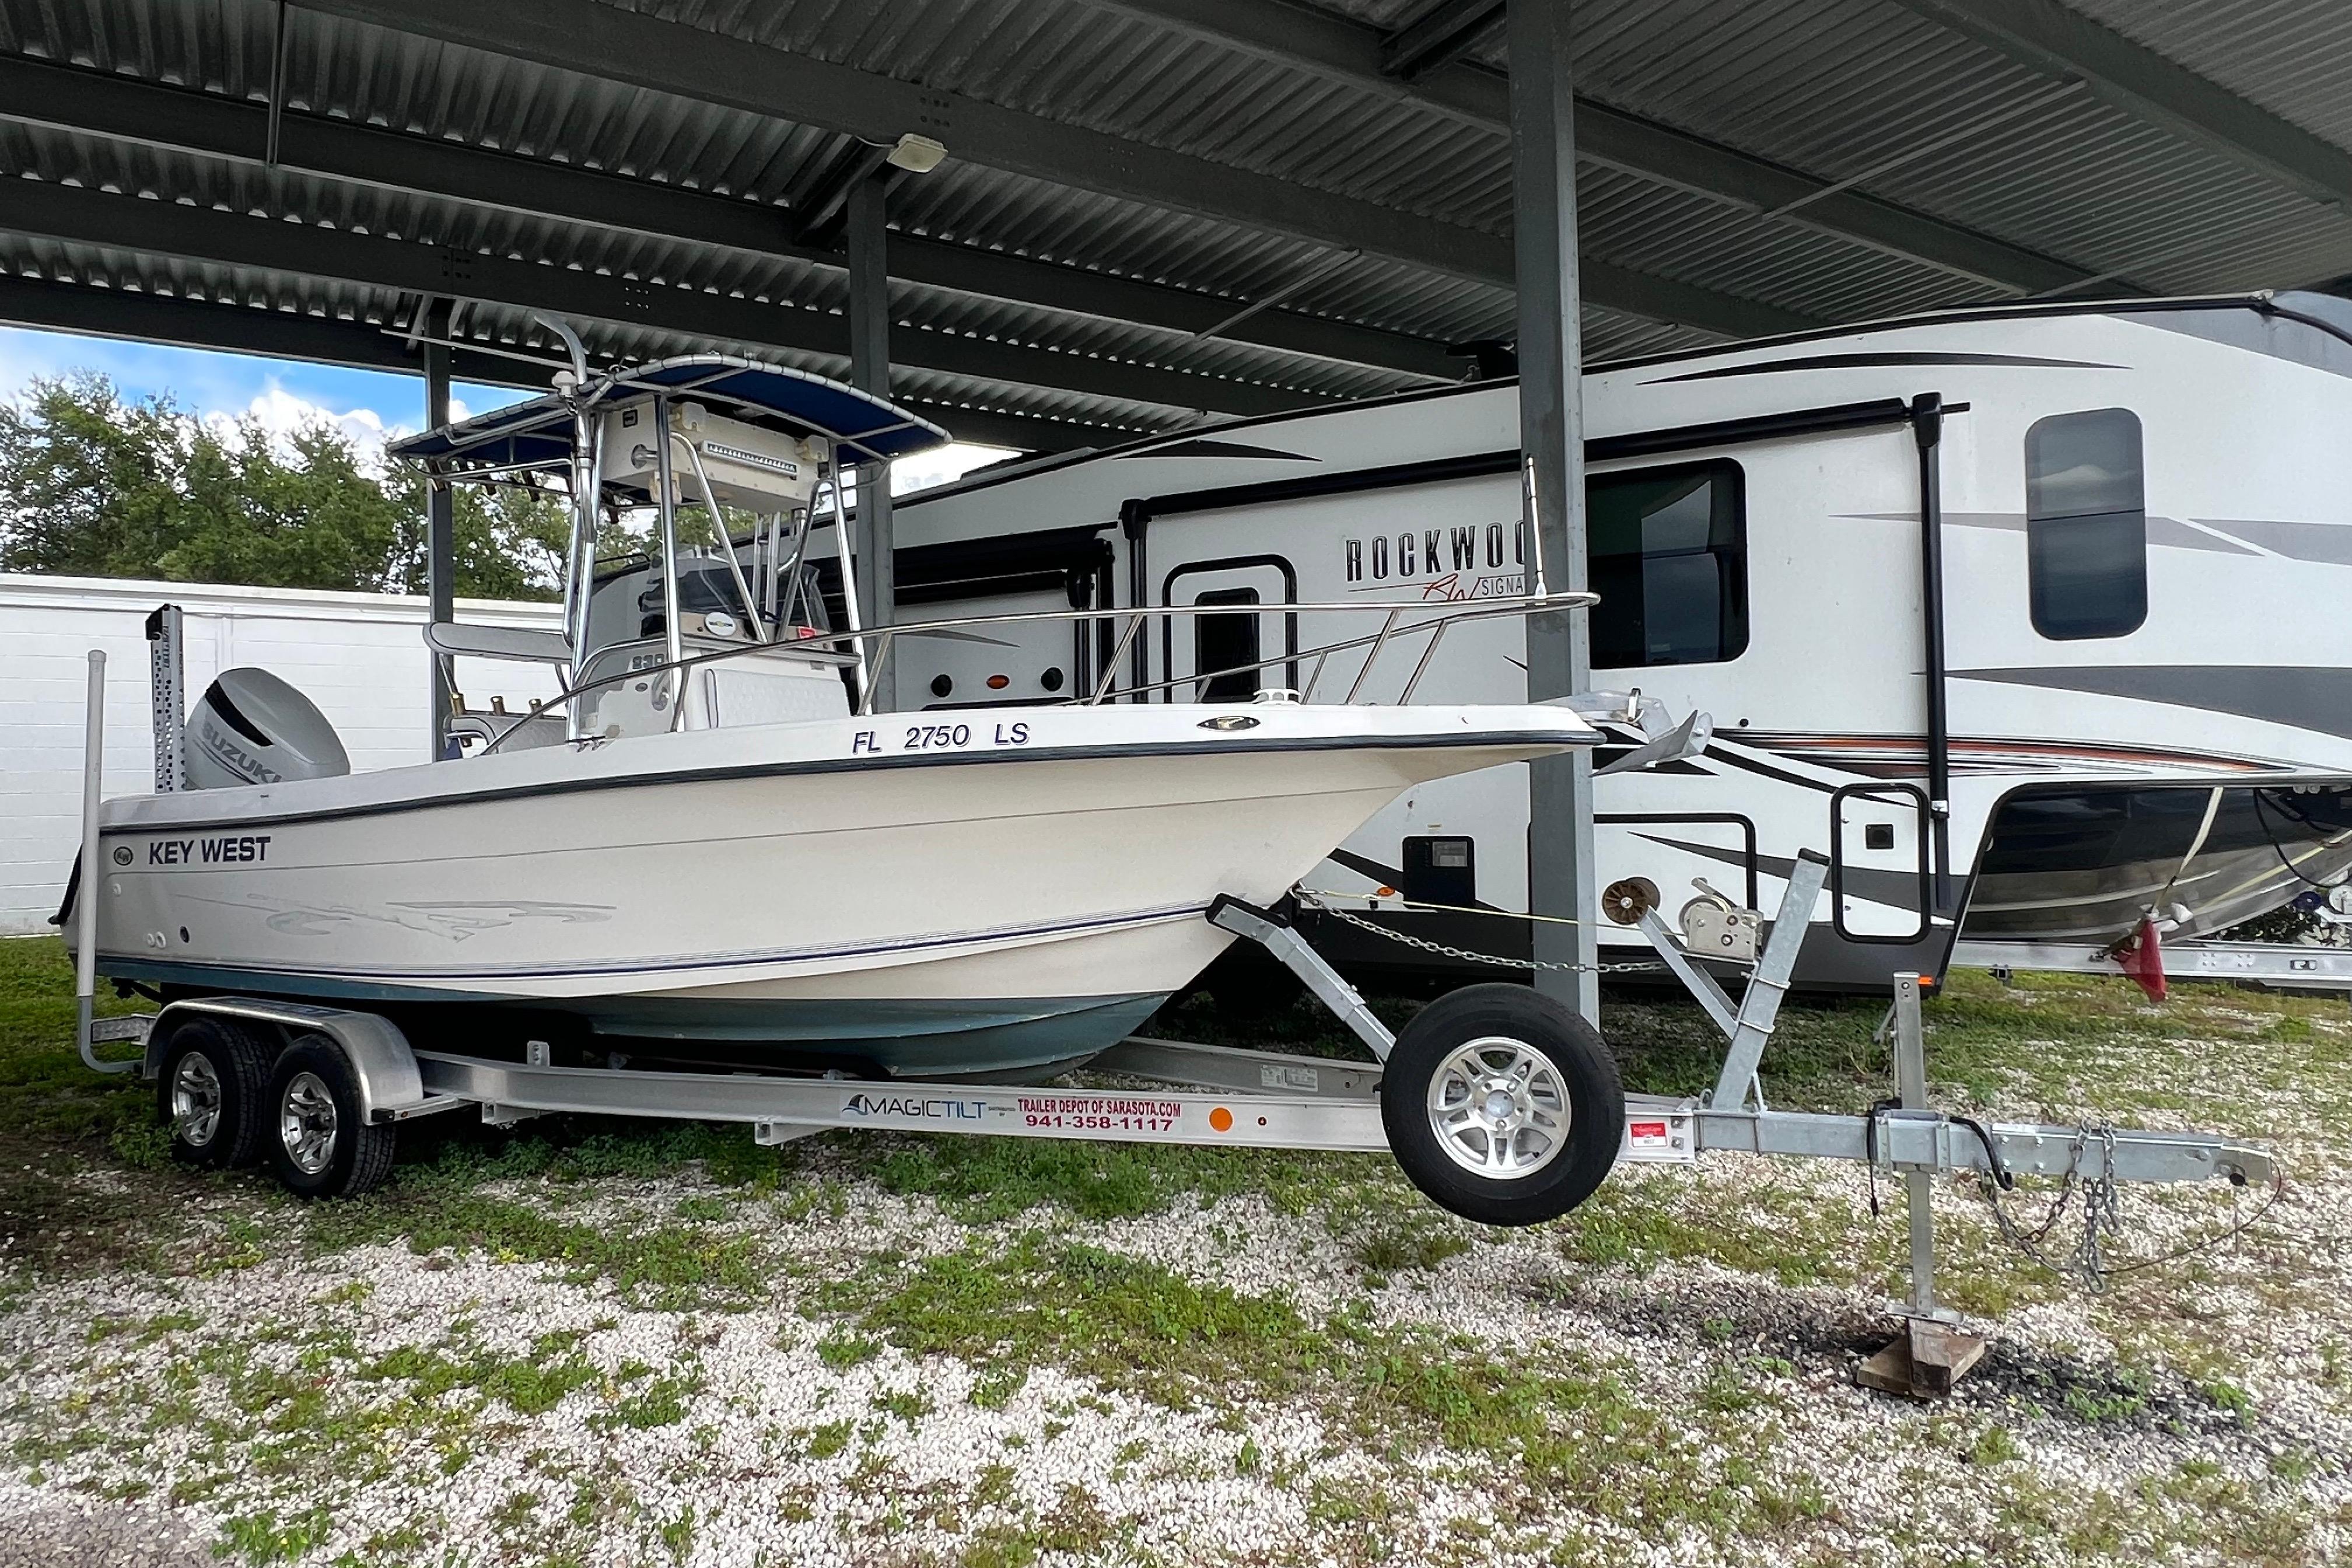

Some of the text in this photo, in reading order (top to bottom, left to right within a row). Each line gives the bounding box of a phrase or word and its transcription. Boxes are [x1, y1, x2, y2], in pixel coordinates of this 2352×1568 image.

[1345, 519, 1525, 582] ROCKWOO
[1481, 577, 1524, 596] SIGNA
[852, 722, 1030, 754] FL 2750 LS
[149, 836, 271, 865] KEY WEST
[864, 1097, 987, 1119] MAGICTILT
[1018, 1098, 1181, 1117] TRAILER DEPOT OF SARASOTA.COM
[1025, 1114, 1173, 1132] 941-358-1117
